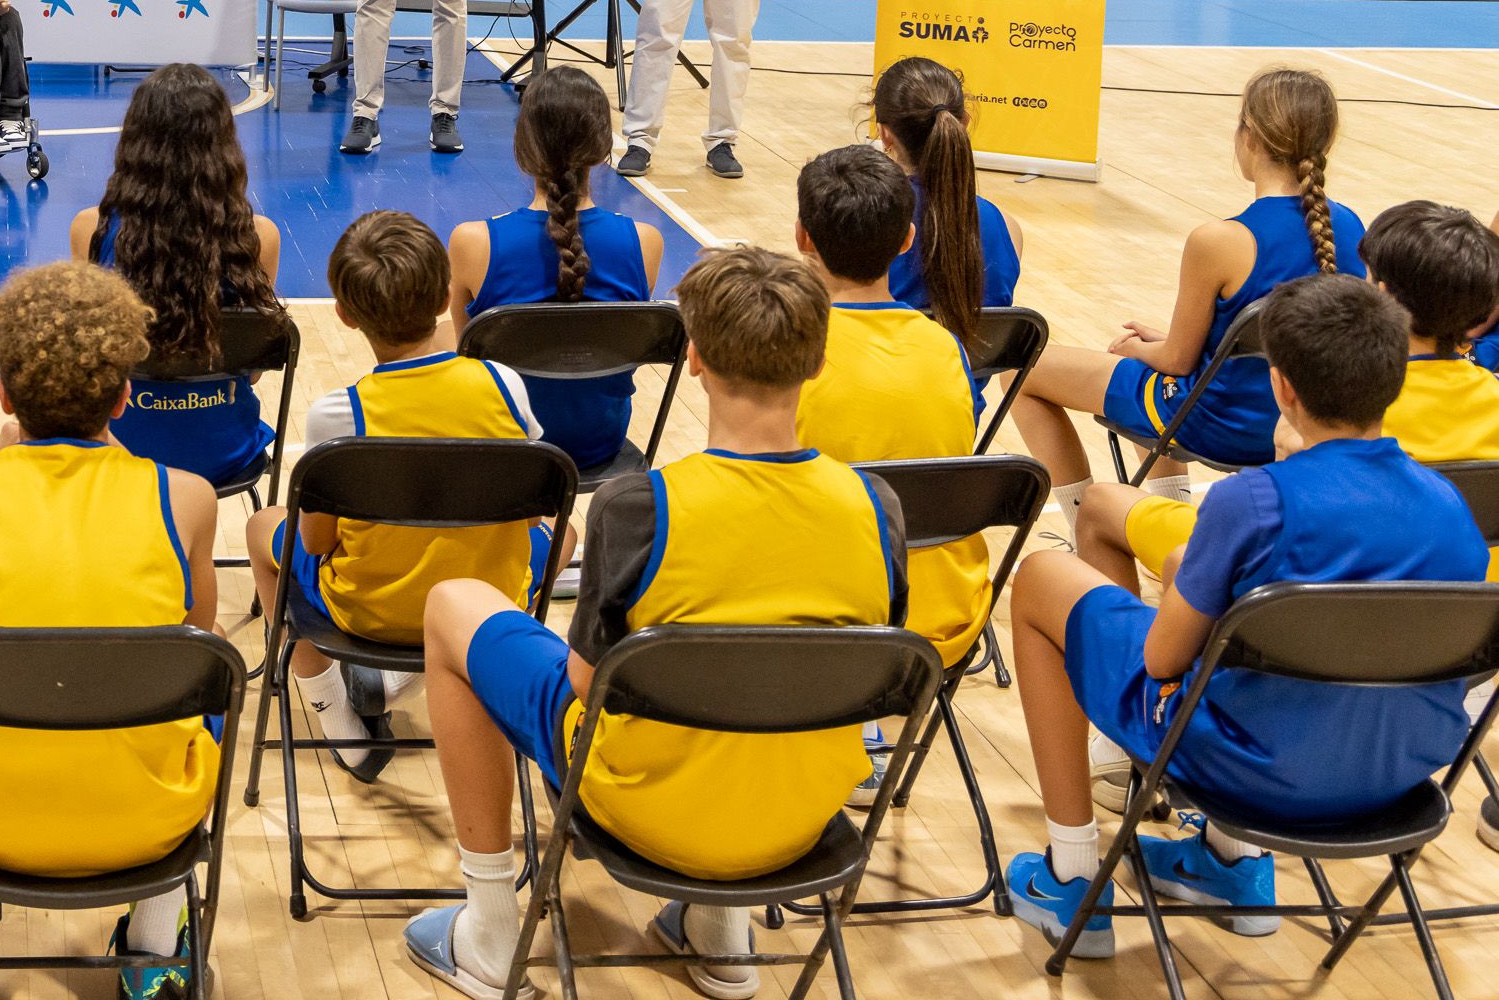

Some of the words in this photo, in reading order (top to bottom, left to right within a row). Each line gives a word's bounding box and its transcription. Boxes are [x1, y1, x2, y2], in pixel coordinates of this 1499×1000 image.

[899, 21, 970, 42] SUMA
[1009, 35, 1076, 51] Carmen
[136, 387, 227, 411] CaixaBank
